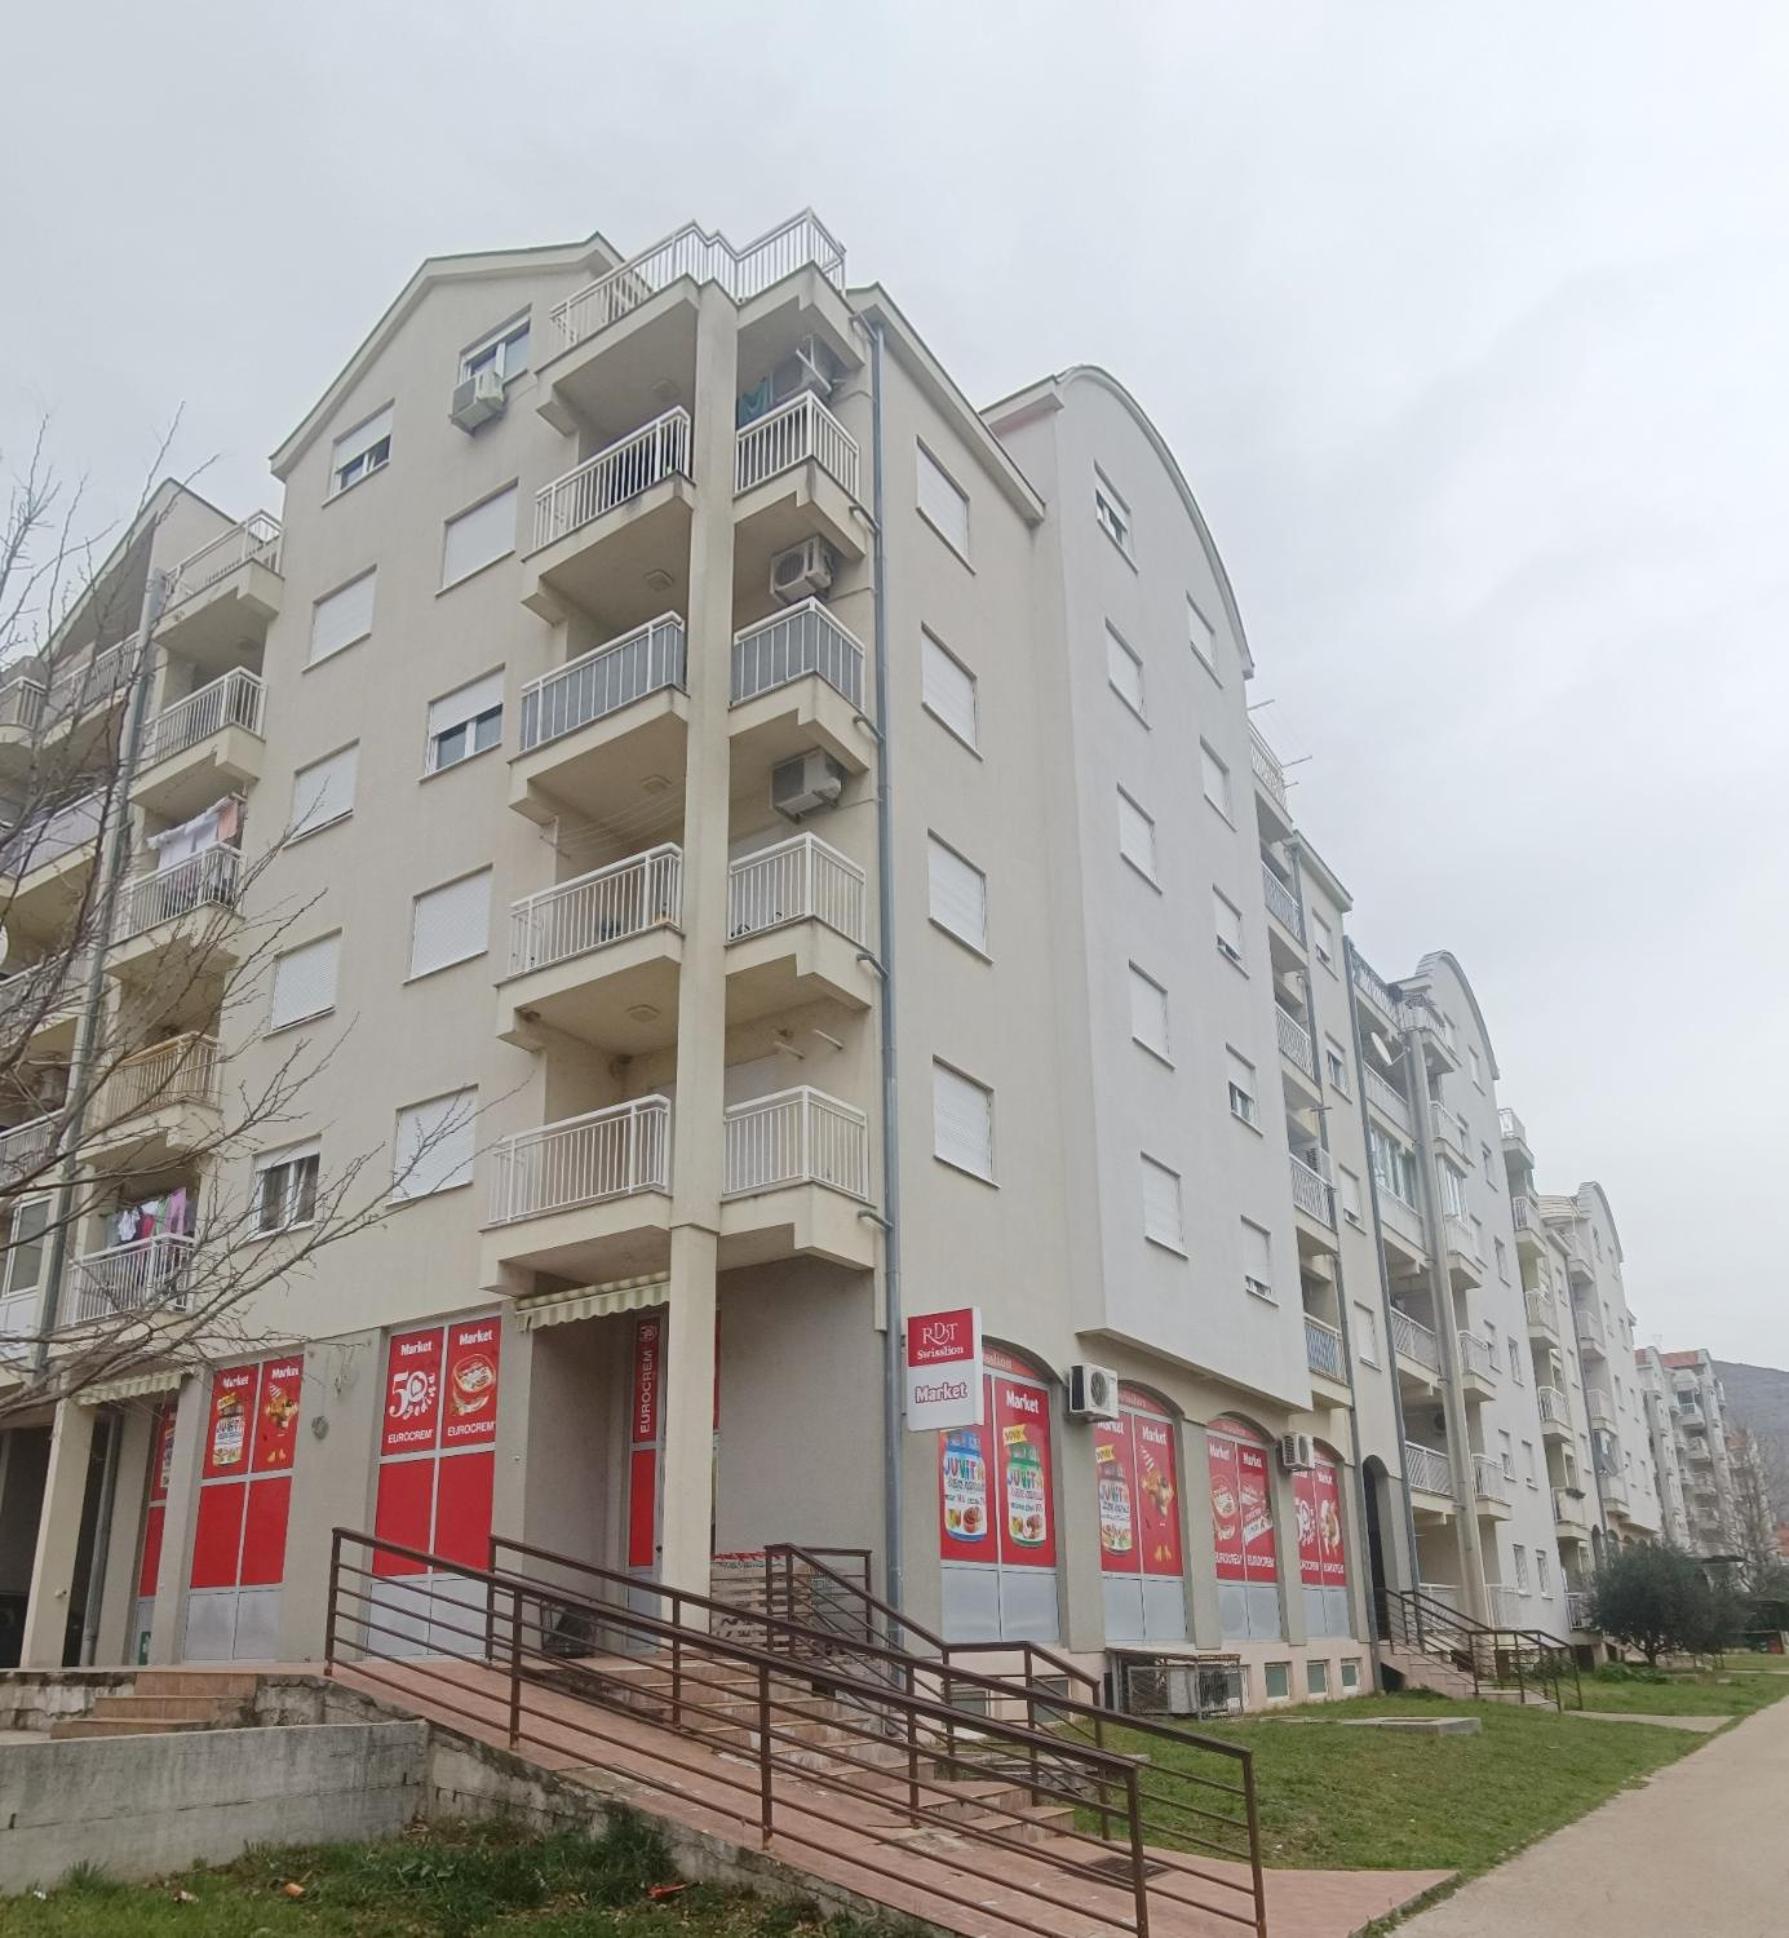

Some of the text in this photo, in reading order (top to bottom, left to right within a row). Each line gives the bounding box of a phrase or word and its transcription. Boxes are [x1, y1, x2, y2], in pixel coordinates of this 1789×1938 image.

[459, 1329, 494, 1346] Market
[401, 1341, 432, 1356] Market
[917, 1346, 964, 1360] Swisslion
[640, 1350, 653, 1434] EUROCREM
[915, 1382, 968, 1403] Market
[1006, 1390, 1039, 1415] Market
[388, 1428, 434, 1444] EUROCREM
[448, 1421, 495, 1436] EUROCREM
